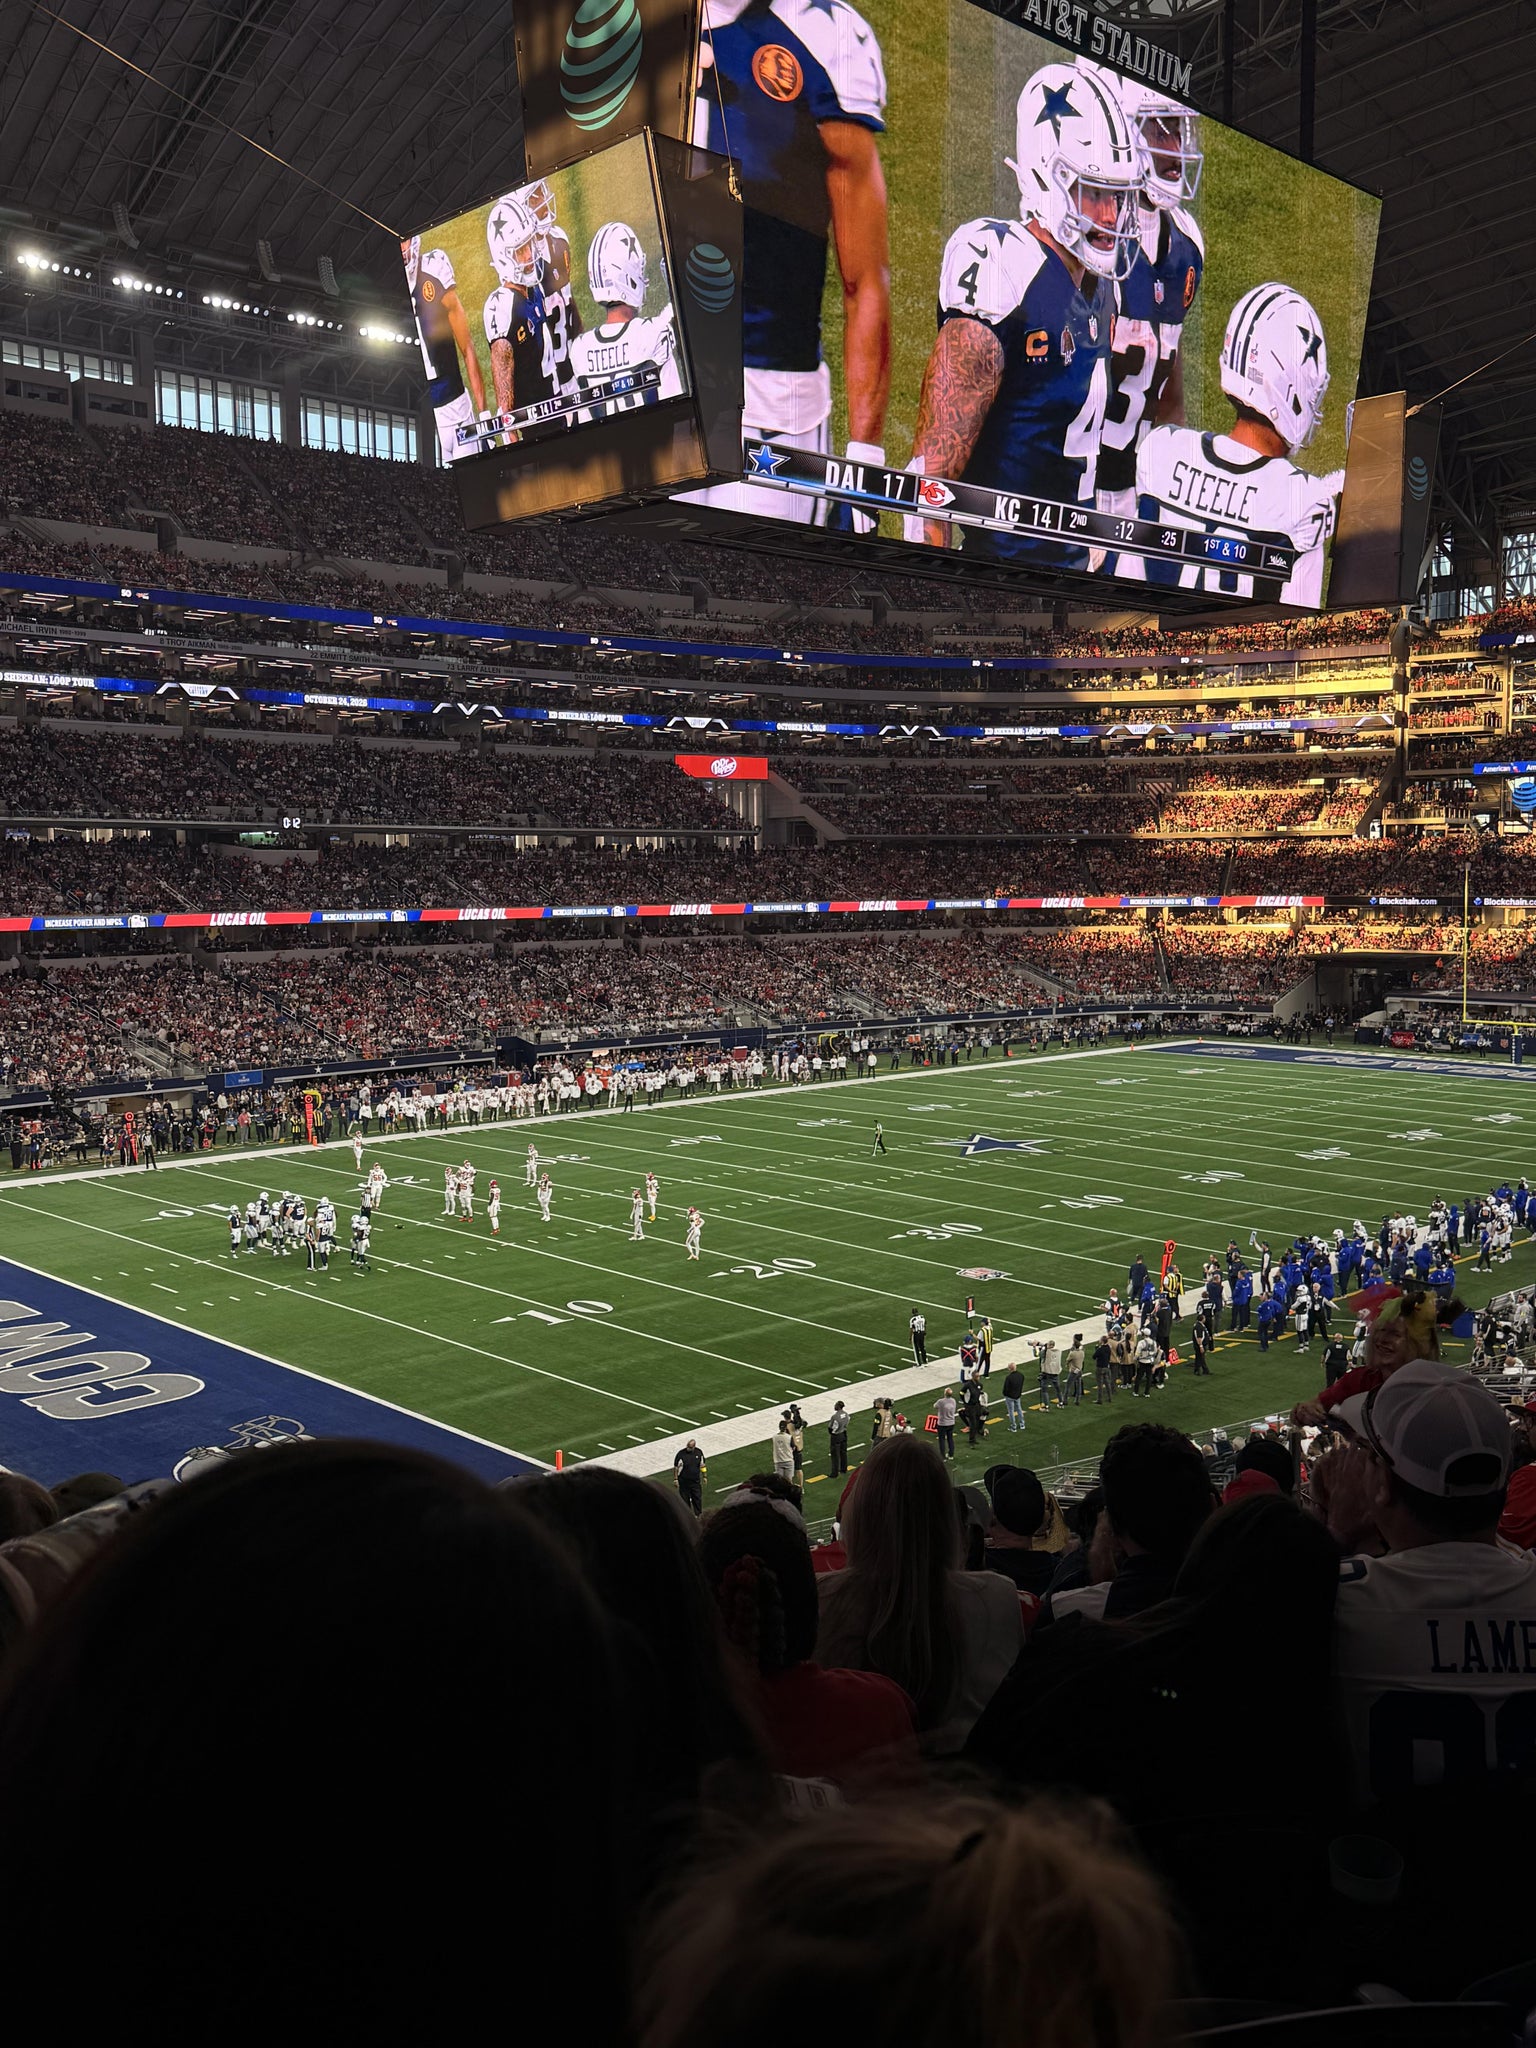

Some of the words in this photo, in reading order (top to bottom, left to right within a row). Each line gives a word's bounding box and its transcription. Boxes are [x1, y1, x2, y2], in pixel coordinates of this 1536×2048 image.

[1023, 0, 1088, 45] AT&T
[1091, 16, 1193, 97] STADIUM
[958, 262, 980, 306] 4
[1025, 330, 1049, 356] C
[587, 342, 630, 372] STEELE
[627, 378, 634, 387] 10
[526, 406, 538, 420] KC
[540, 403, 549, 416] 14
[475, 421, 489, 435] DAL
[492, 418, 500, 431] 17
[1063, 357, 1107, 502] 4
[825, 460, 867, 494] DAL
[883, 473, 905, 500] 17
[1168, 460, 1259, 523] STEELE
[994, 495, 1020, 522] KC
[1032, 503, 1051, 529] 14
[1069, 511, 1087, 529] 2ND
[1115, 521, 1135, 541] :12
[1161, 531, 1177, 547] :25
[1203, 536, 1222, 553] 1ST
[1222, 542, 1230, 556] &
[1233, 544, 1247, 559] 10
[35, 625, 57, 635] IRVIN
[166, 638, 186, 647] TROY
[187, 640, 216, 649] AIKMAN
[320, 653, 346, 661] EMMITT
[348, 655, 370, 663] SMITH
[457, 664, 479, 672] LARRY
[480, 666, 501, 674] ALLEN
[4, 672, 49, 685] SHEERAN:
[49, 674, 71, 687] LOOP
[72, 677, 95, 688] TOUR
[304, 694, 338, 705] OCTOBER
[1483, 765, 1511, 773] American
[858, 900, 885, 911] LUCAS
[885, 900, 899, 911] OIL
[1041, 897, 1069, 908] LUCAS
[1070, 897, 1086, 907] OIL
[1255, 896, 1287, 906] LUCAS
[1288, 896, 1304, 906] OIL
[1379, 897, 1437, 905] Blockchain.com
[458, 908, 490, 920] LUCAS
[491, 908, 508, 920] OIL
[669, 904, 698, 915] LUCAS
[698, 904, 713, 915] OIL
[44, 919, 73, 928] INCREASE
[73, 919, 93, 927] POWER
[93, 918, 105, 927] AND
[209, 912, 247, 926] LUCAS
[248, 912, 268, 925] OIL
[1060, 1195, 1124, 1209] 40
[906, 1223, 983, 1240] 30
[730, 1257, 817, 1279] 20
[517, 1300, 614, 1326] 10
